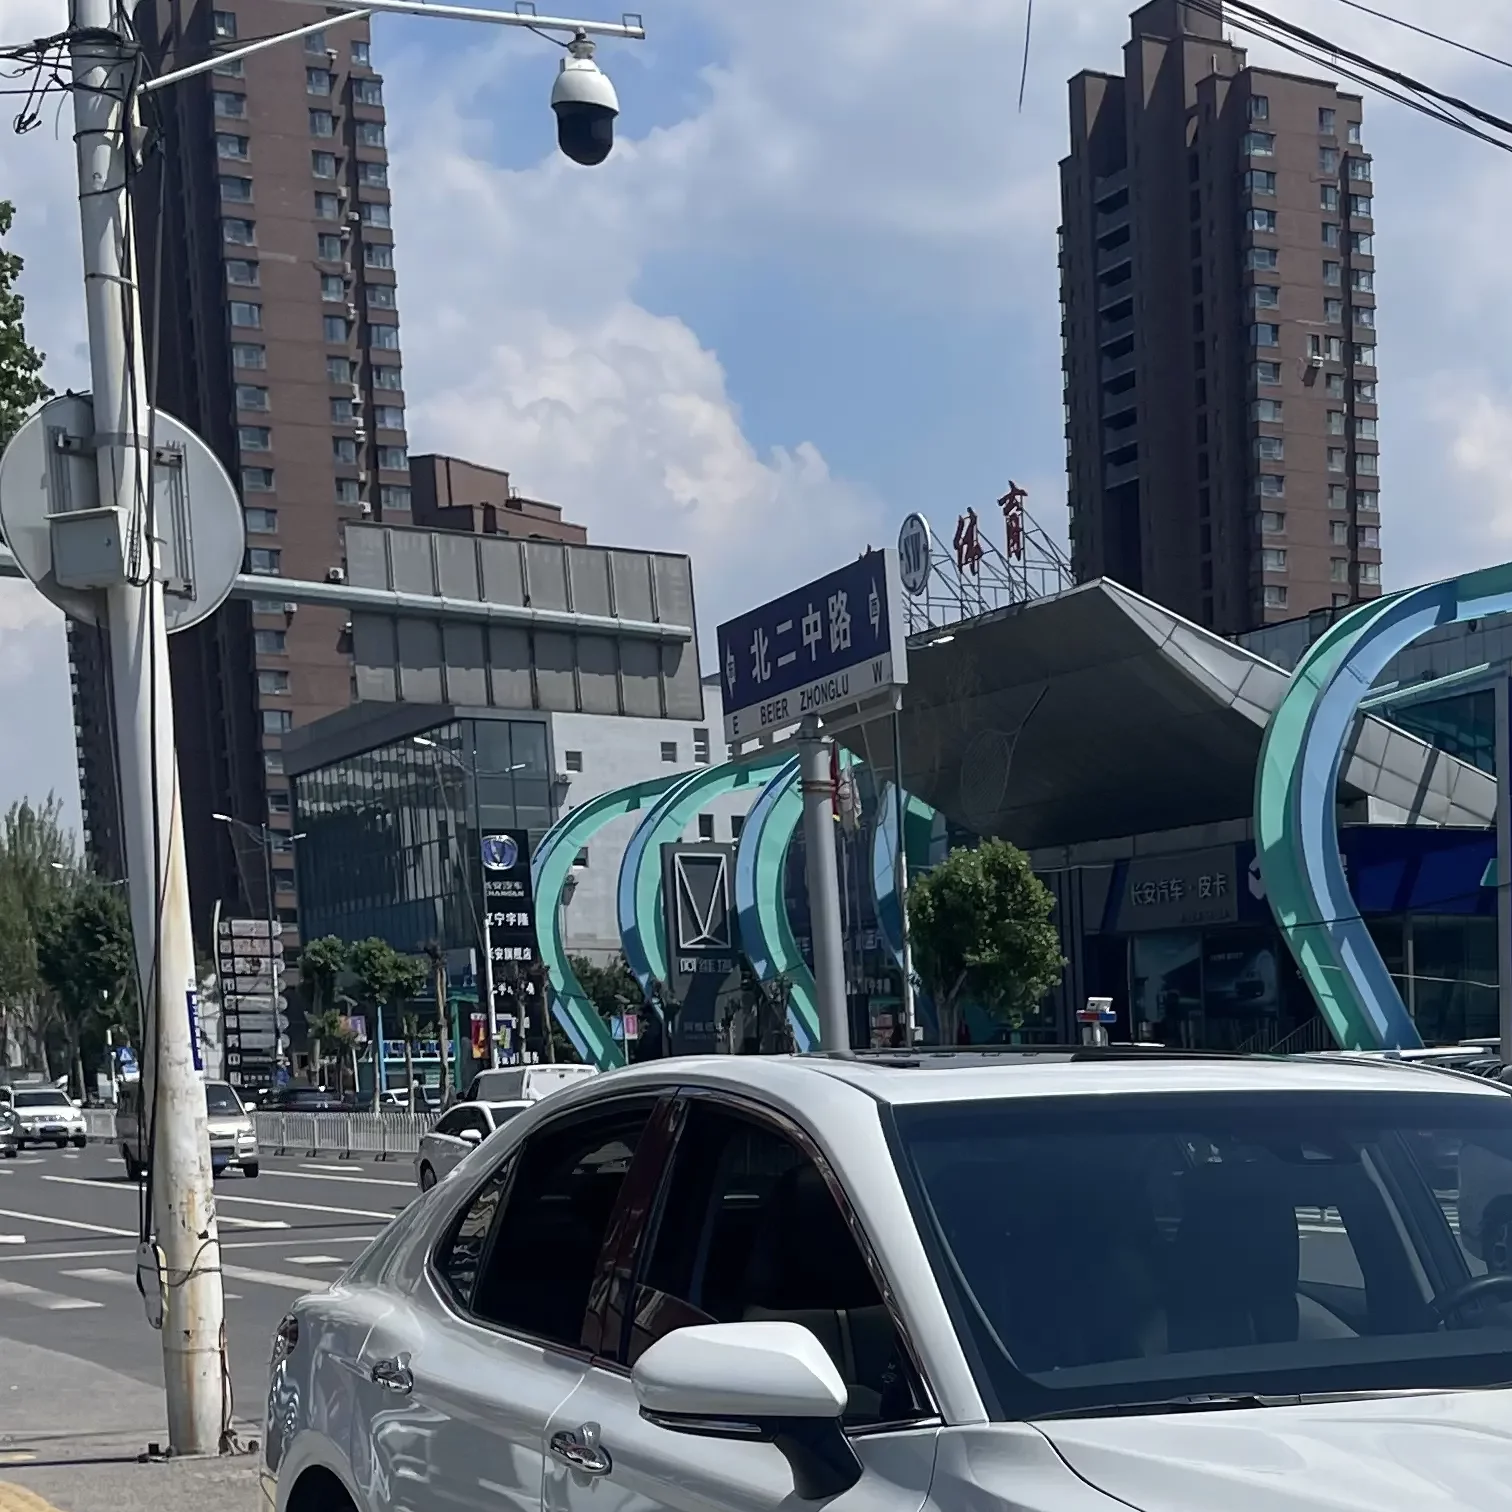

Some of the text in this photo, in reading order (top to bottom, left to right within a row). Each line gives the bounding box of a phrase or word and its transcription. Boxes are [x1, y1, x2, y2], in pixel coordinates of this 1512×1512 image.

[953, 479, 1028, 577] 体育
[750, 589, 852, 684] 北二中路
[732, 659, 883, 735] E BEIER ZHONGLU W
